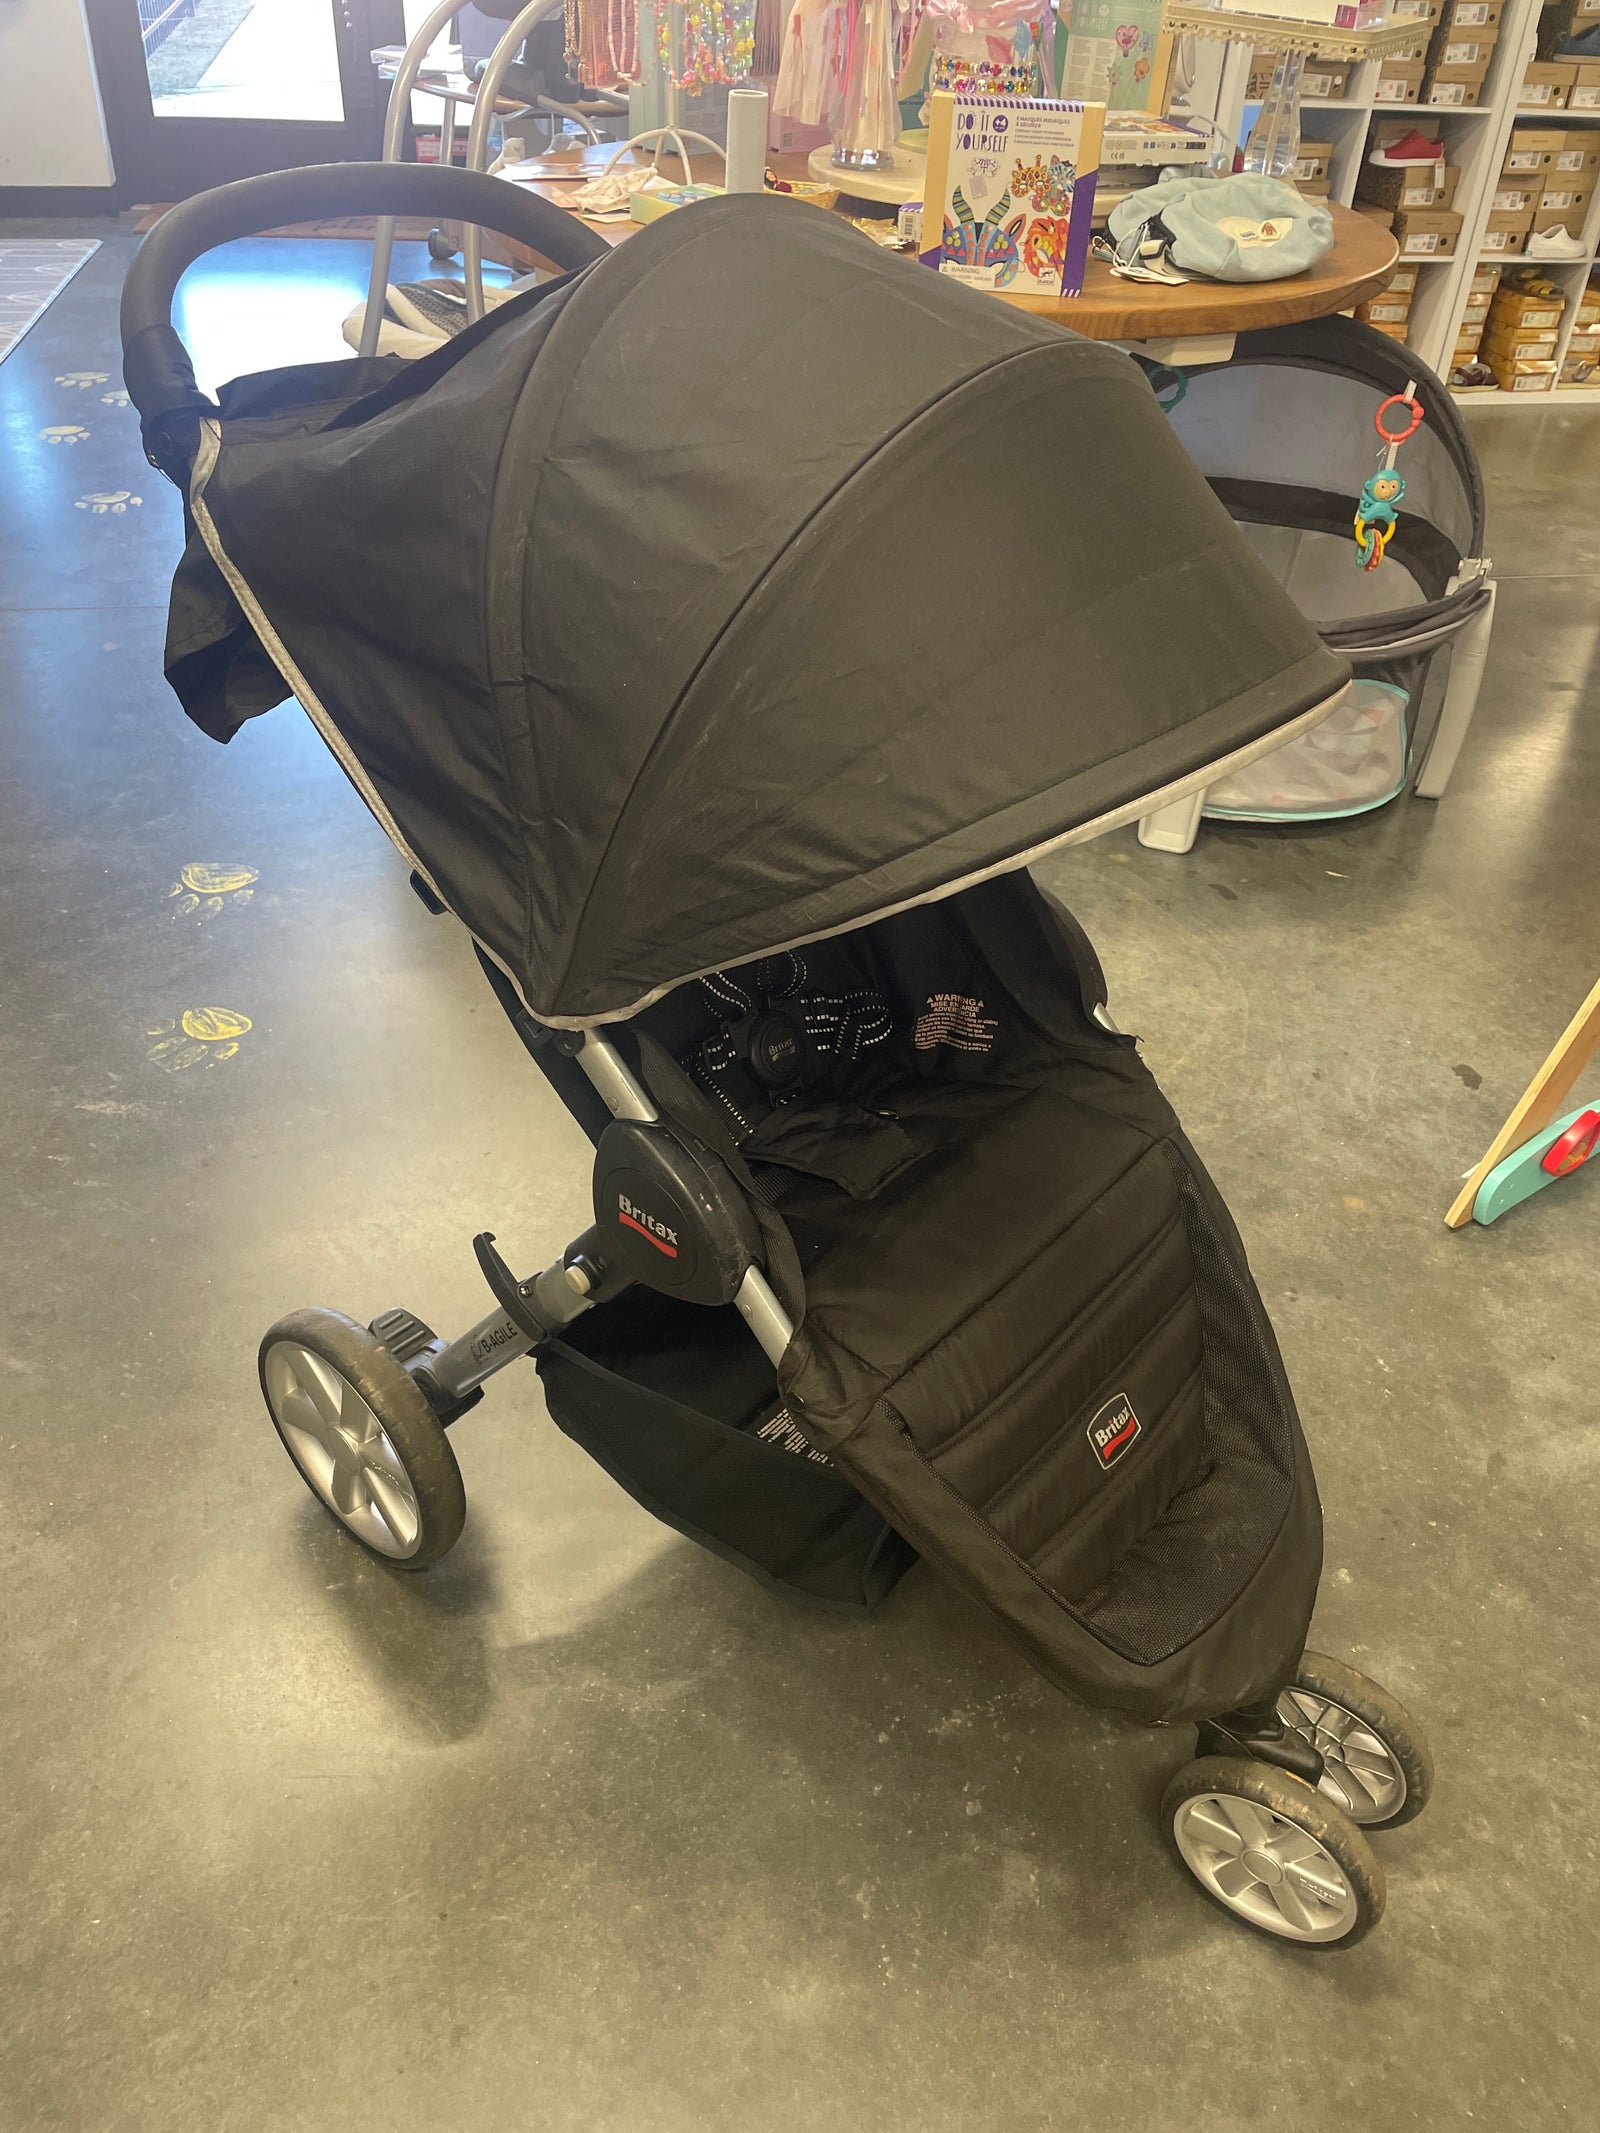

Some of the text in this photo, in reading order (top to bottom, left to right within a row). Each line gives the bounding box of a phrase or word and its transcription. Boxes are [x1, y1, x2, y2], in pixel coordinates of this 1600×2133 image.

[957, 111, 990, 132] DO IT
[956, 133, 1009, 153] YOURSELF
[618, 1193, 678, 1246] Britax
[481, 1322, 518, 1353] B-AGILE
[1094, 1406, 1131, 1448] Britax
